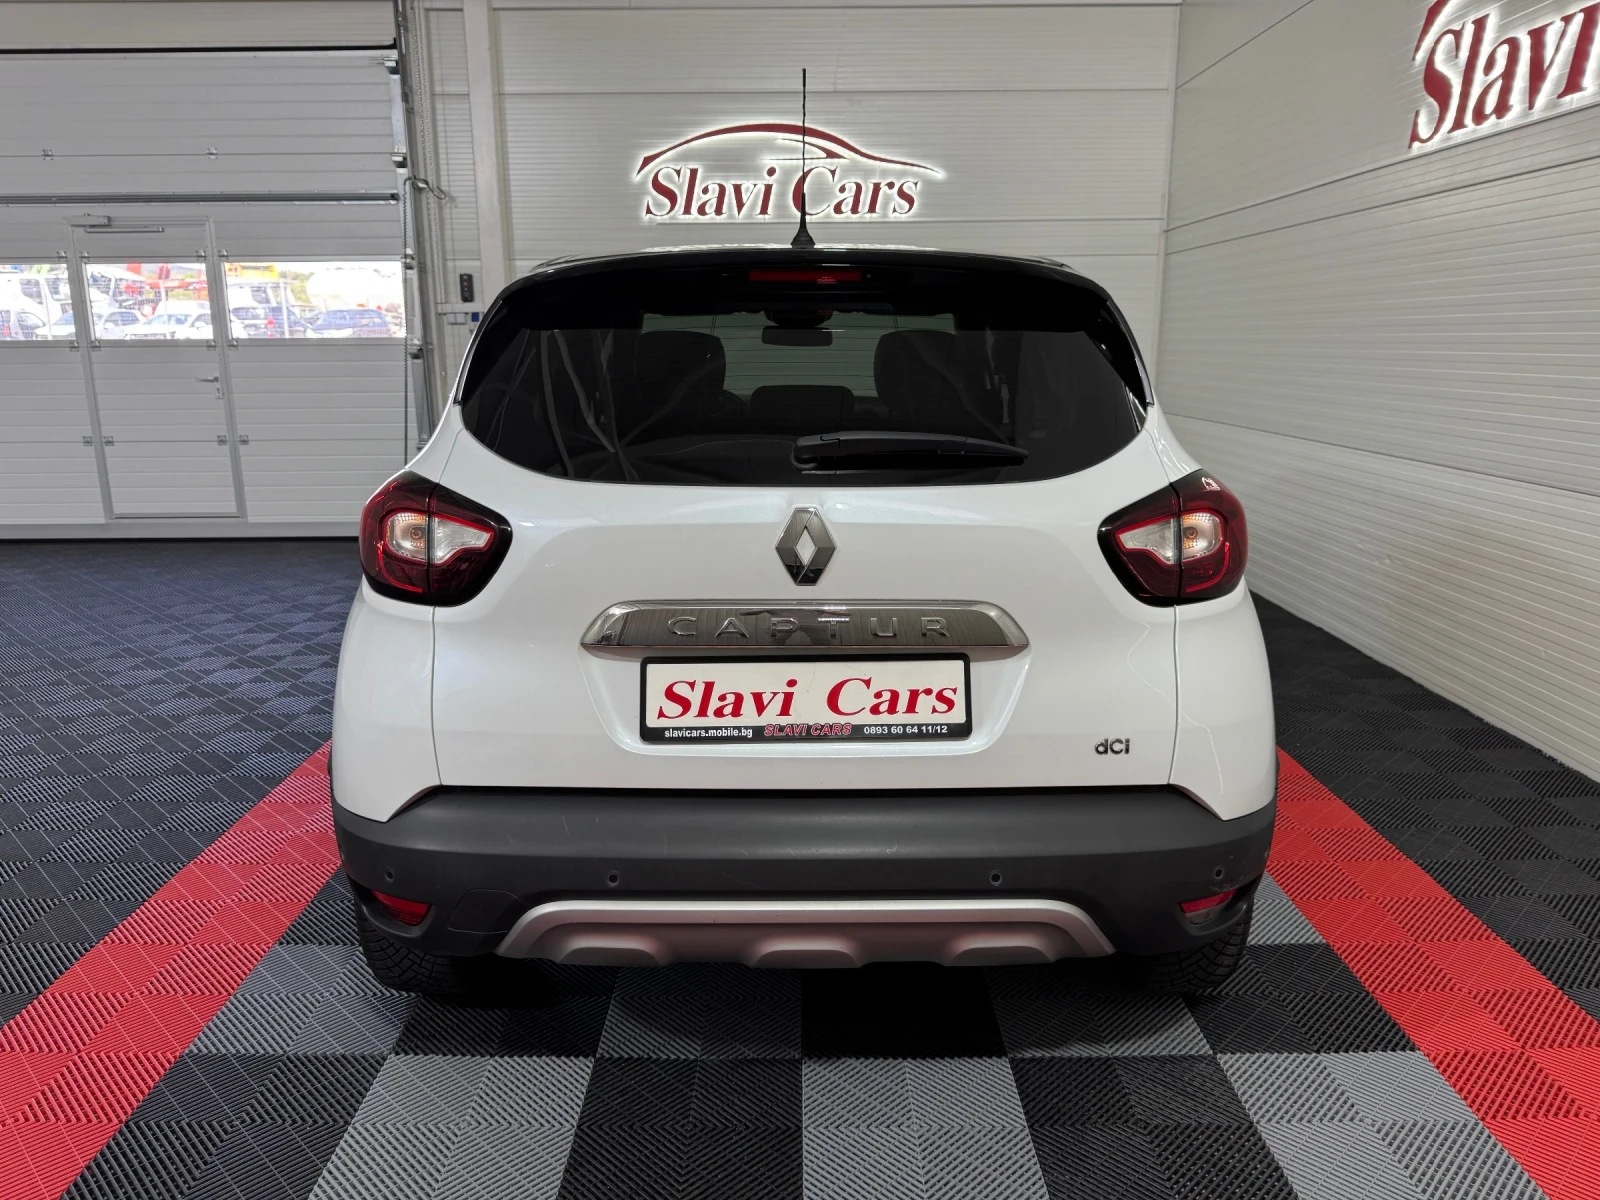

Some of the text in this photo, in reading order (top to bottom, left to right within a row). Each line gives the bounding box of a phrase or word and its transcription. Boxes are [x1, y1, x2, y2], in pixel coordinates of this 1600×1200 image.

[645, 166, 920, 217] Slavi Cars
[667, 616, 951, 639] CAPTUR
[657, 677, 958, 719] Slavi Cars
[664, 727, 753, 738] slavicars.mobile.bg
[763, 723, 852, 737] SLAVI CARS
[863, 725, 948, 734] 0893 60 64 11/12
[1094, 738, 1130, 755] dCi
